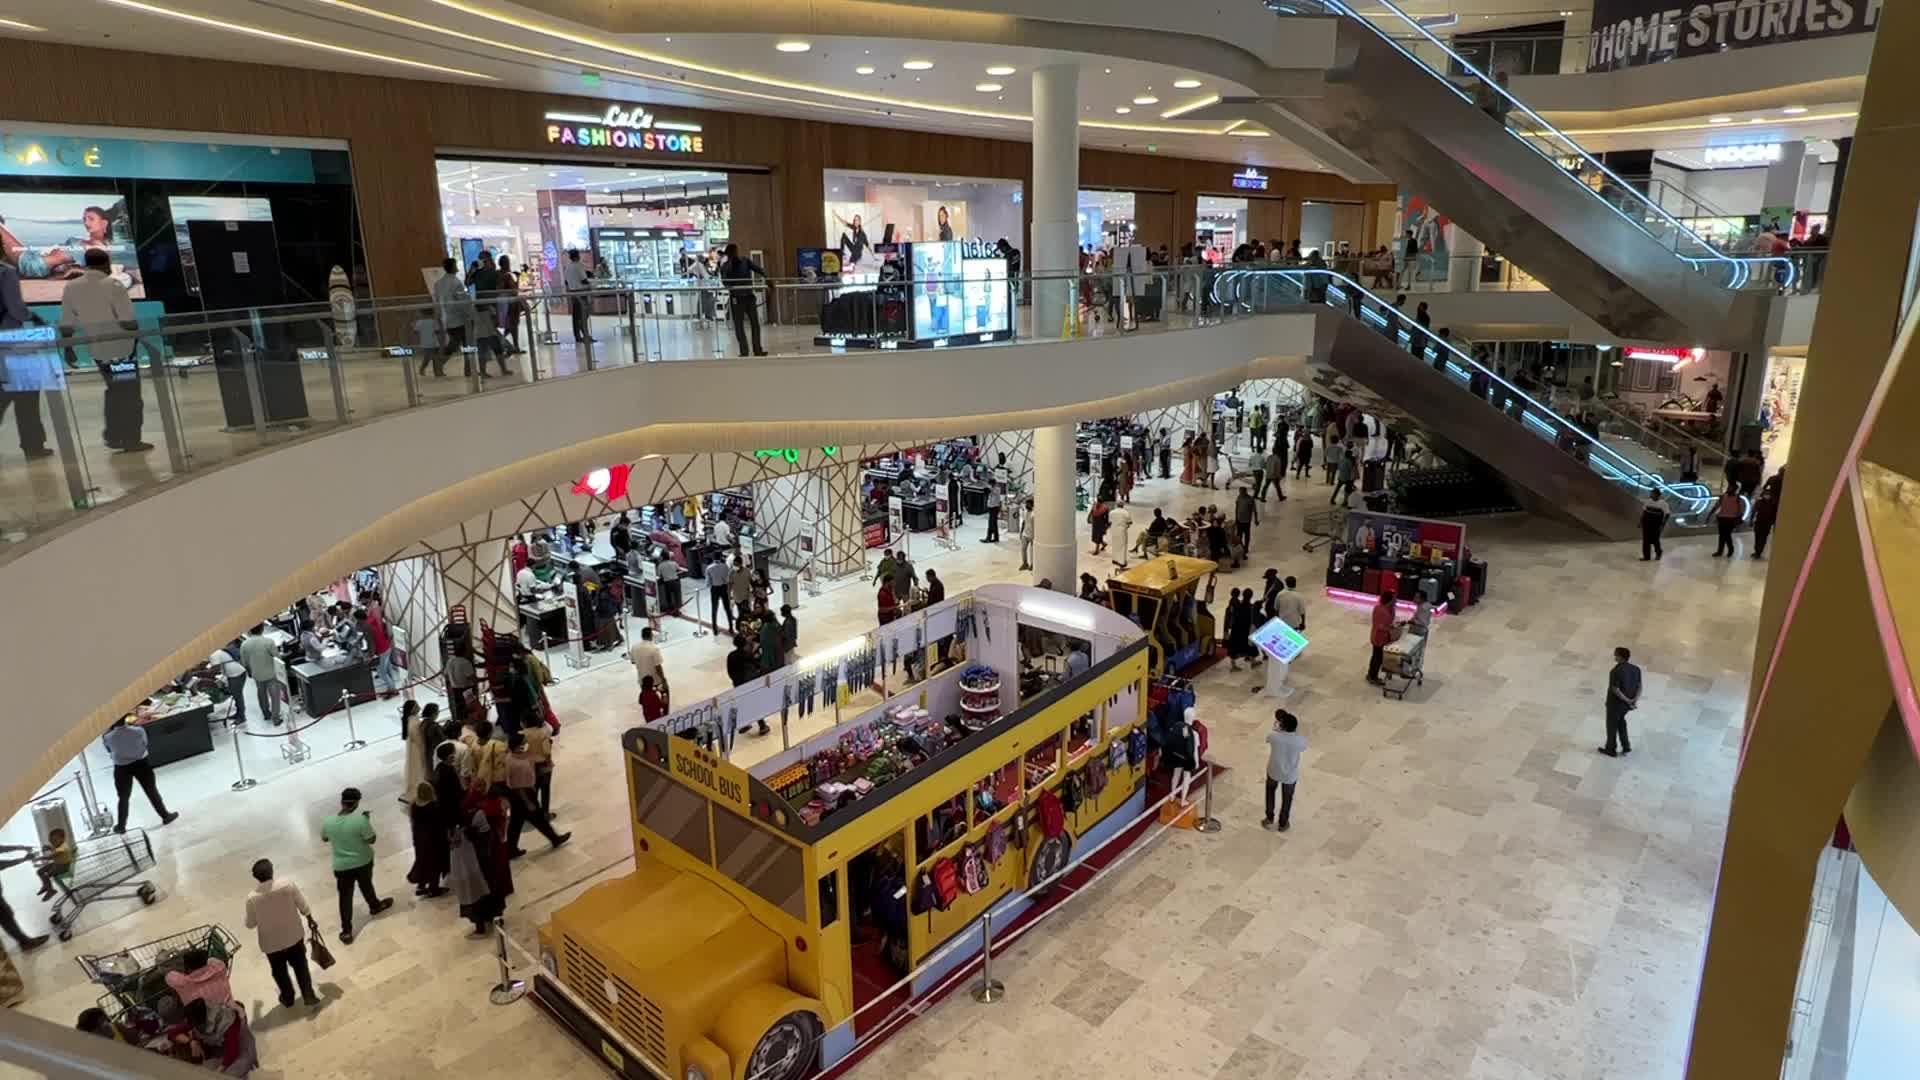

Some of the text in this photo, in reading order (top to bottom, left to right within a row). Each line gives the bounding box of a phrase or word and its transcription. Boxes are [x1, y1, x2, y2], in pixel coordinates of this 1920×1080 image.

[1600, 9, 1681, 64] HOME
[1687, 0, 1854, 48] STORIES
[547, 124, 704, 153] FASHION STORE
[675, 753, 742, 804] SCHOOL BUS
